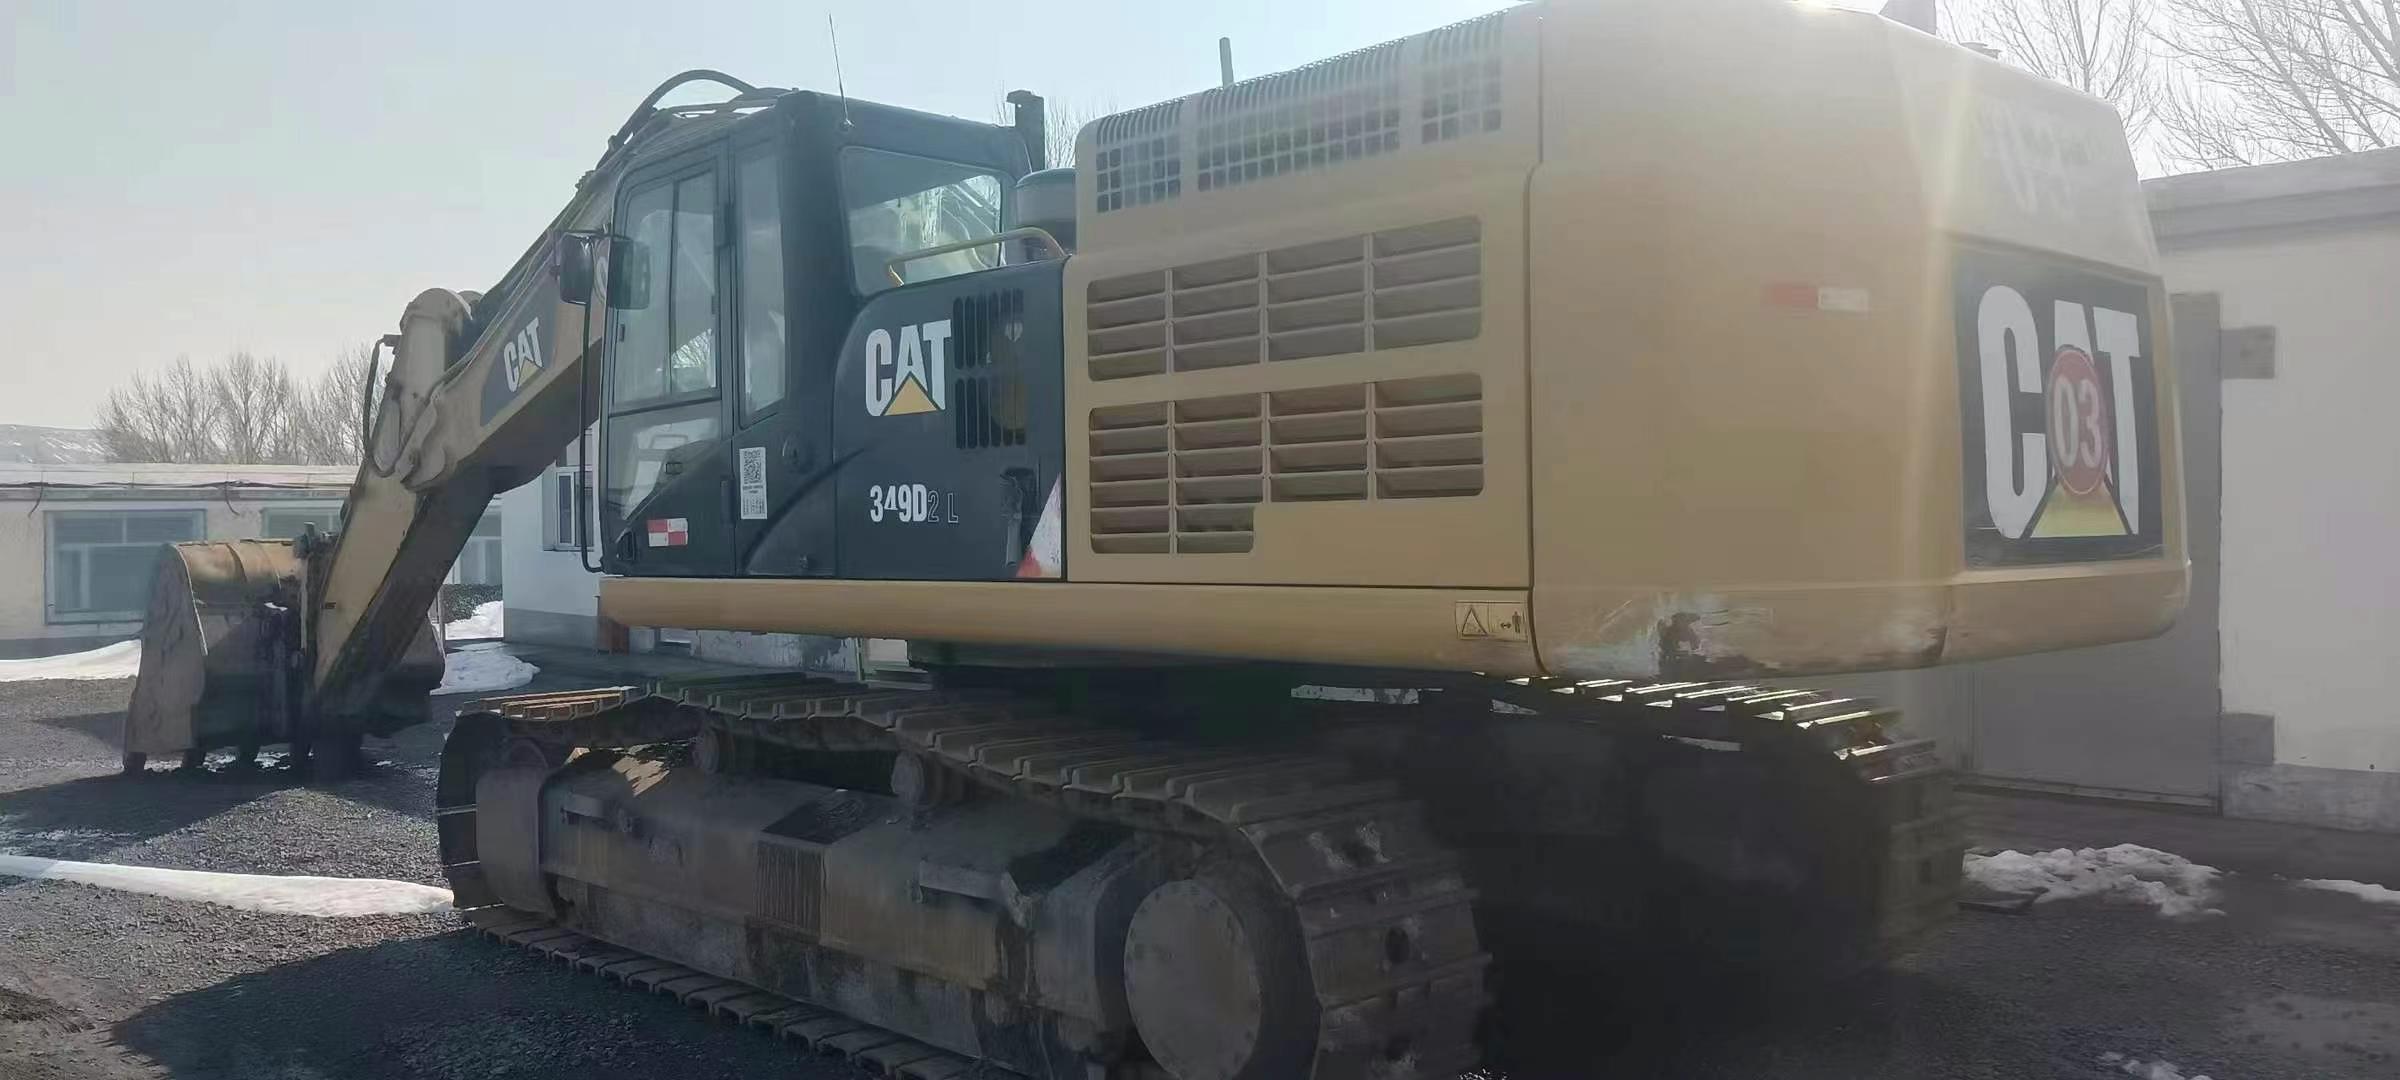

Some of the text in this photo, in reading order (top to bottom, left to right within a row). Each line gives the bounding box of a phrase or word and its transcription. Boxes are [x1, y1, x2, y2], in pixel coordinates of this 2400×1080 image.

[505, 317, 543, 392] CAT
[865, 319, 951, 417] CAT
[2053, 375, 2103, 468] 03
[947, 493, 959, 523] L
